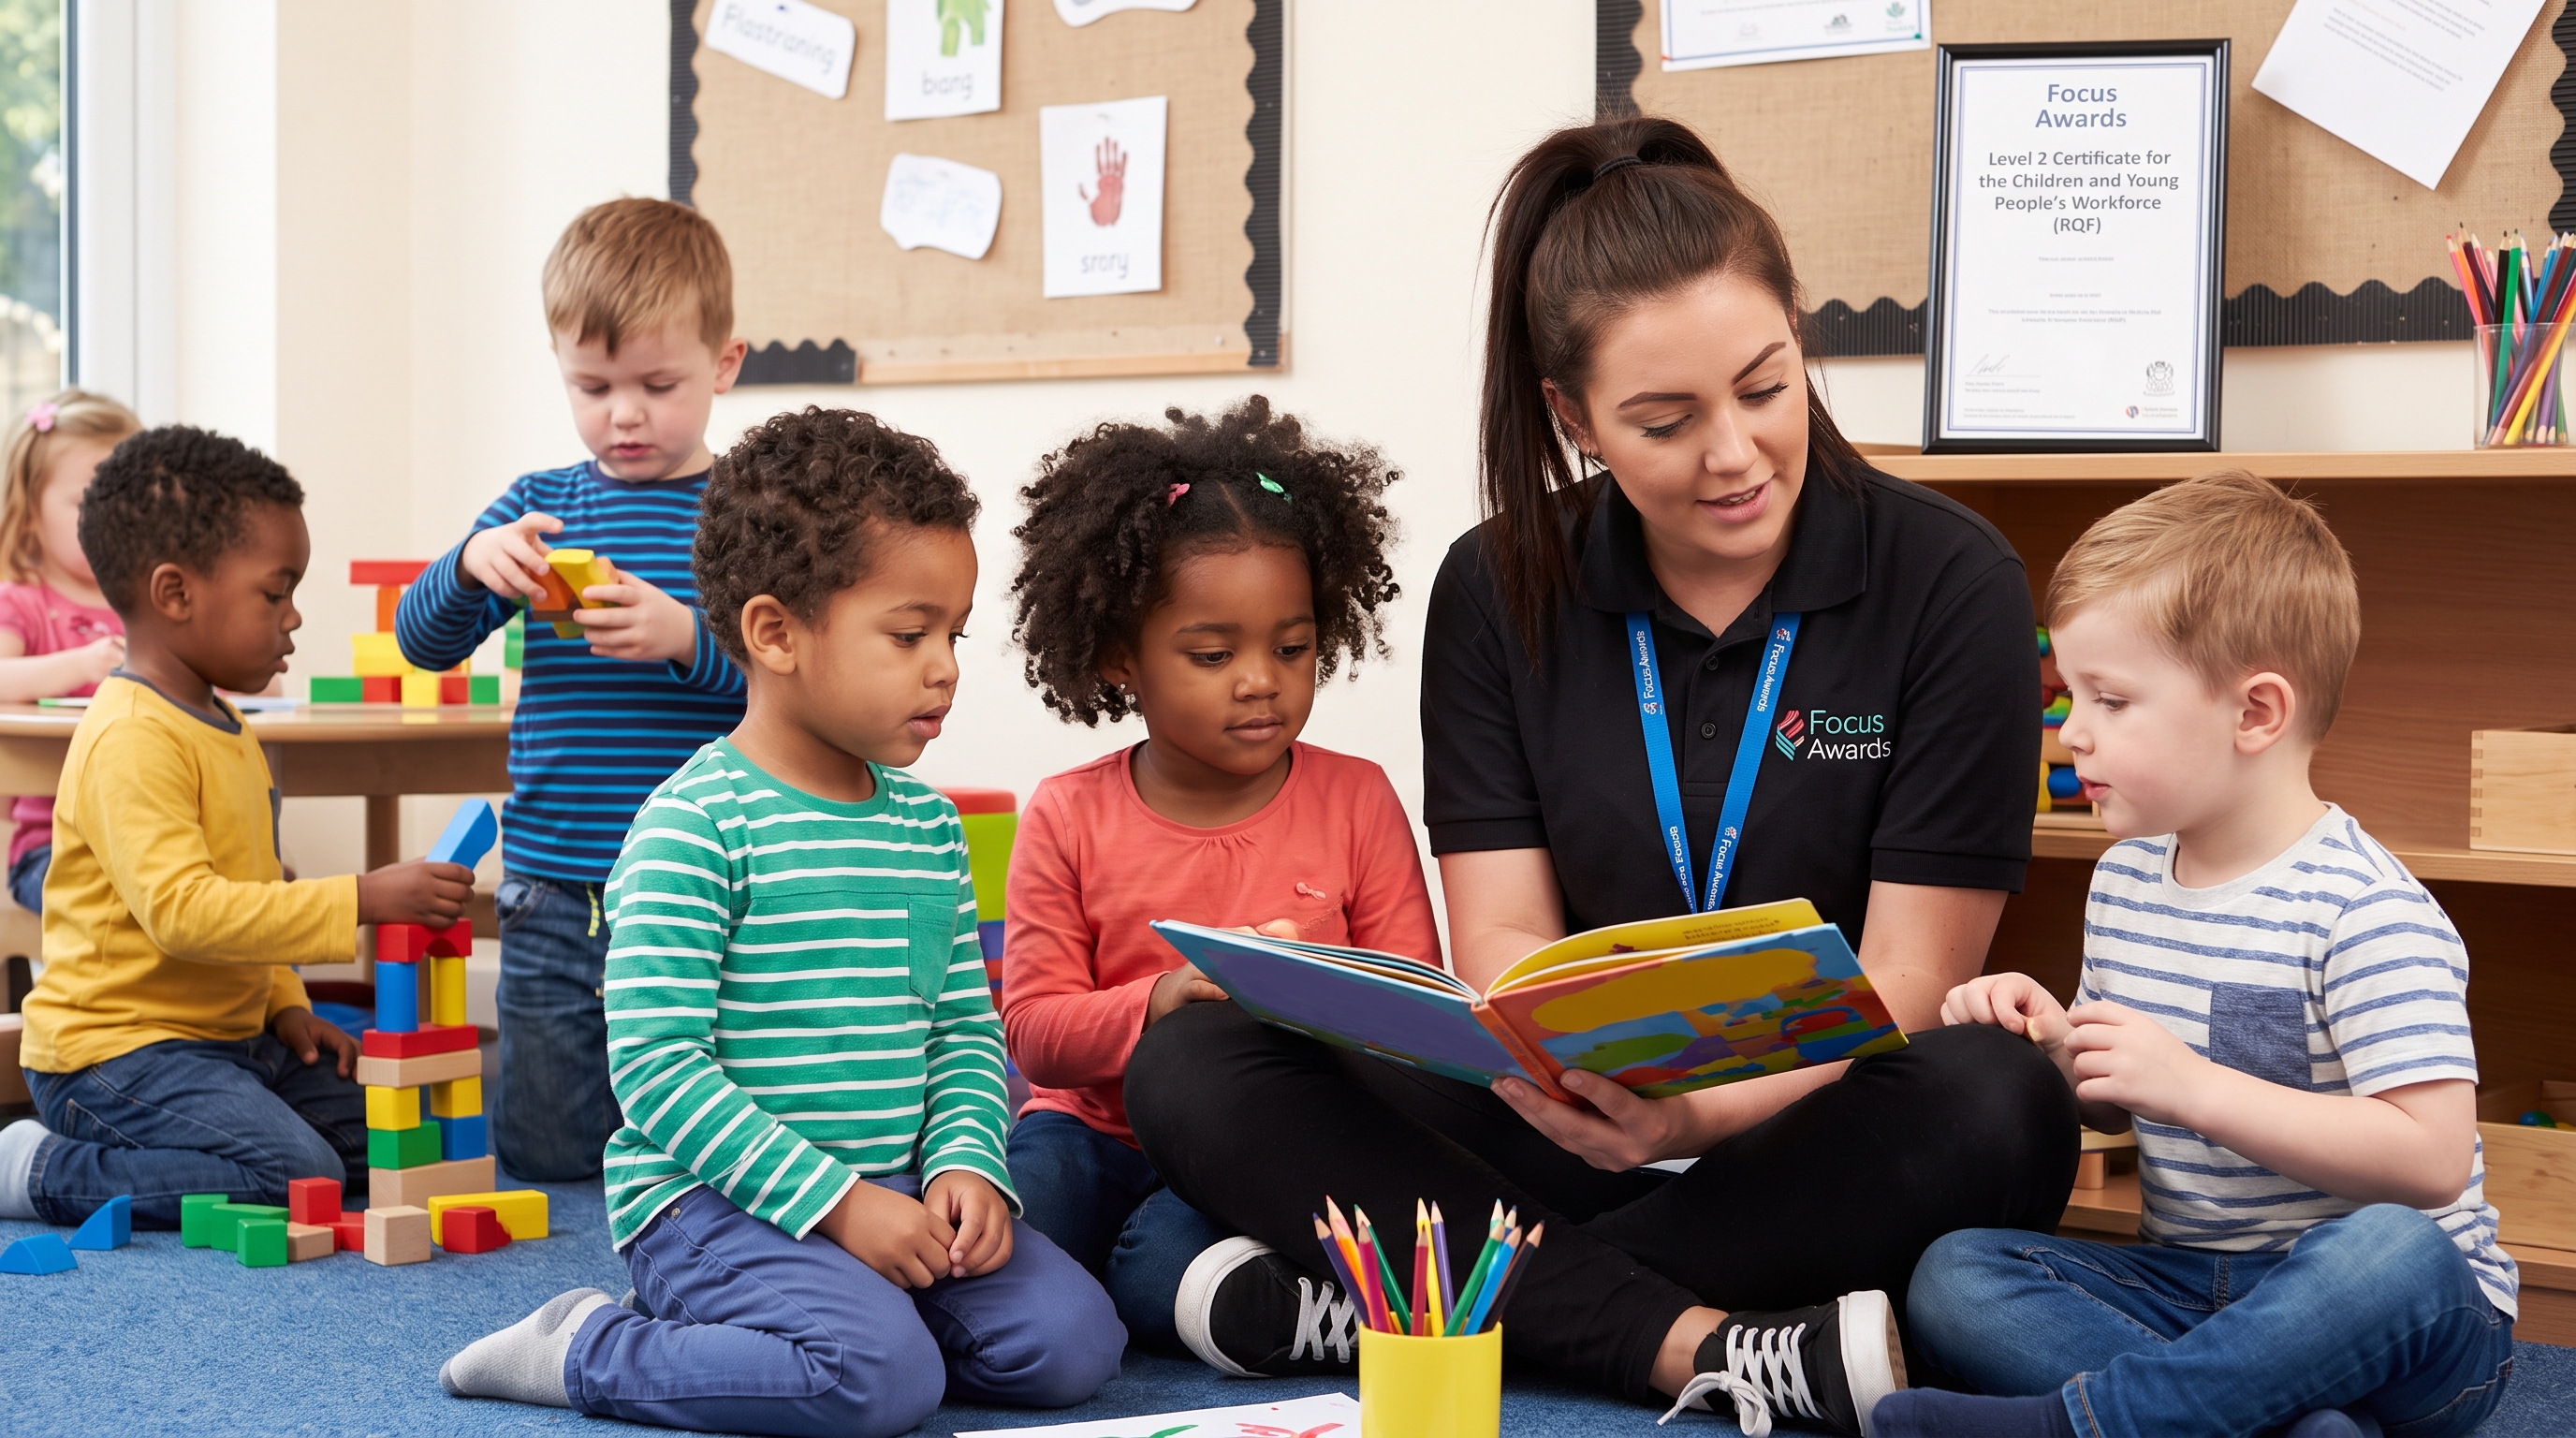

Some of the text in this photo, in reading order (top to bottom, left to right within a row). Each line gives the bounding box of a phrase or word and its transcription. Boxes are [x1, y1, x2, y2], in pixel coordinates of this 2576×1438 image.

[2047, 83, 2117, 103] Focus
[2035, 108, 2127, 128] Awards
[1989, 150, 2172, 166] Level 2 Certificate for
[1979, 172, 2179, 190] the Children and Young
[1995, 195, 2161, 213] People's Workforce
[2053, 216, 2101, 235] (RQF)
[1810, 710, 1885, 735] Focus
[1808, 737, 1892, 760] Awards
